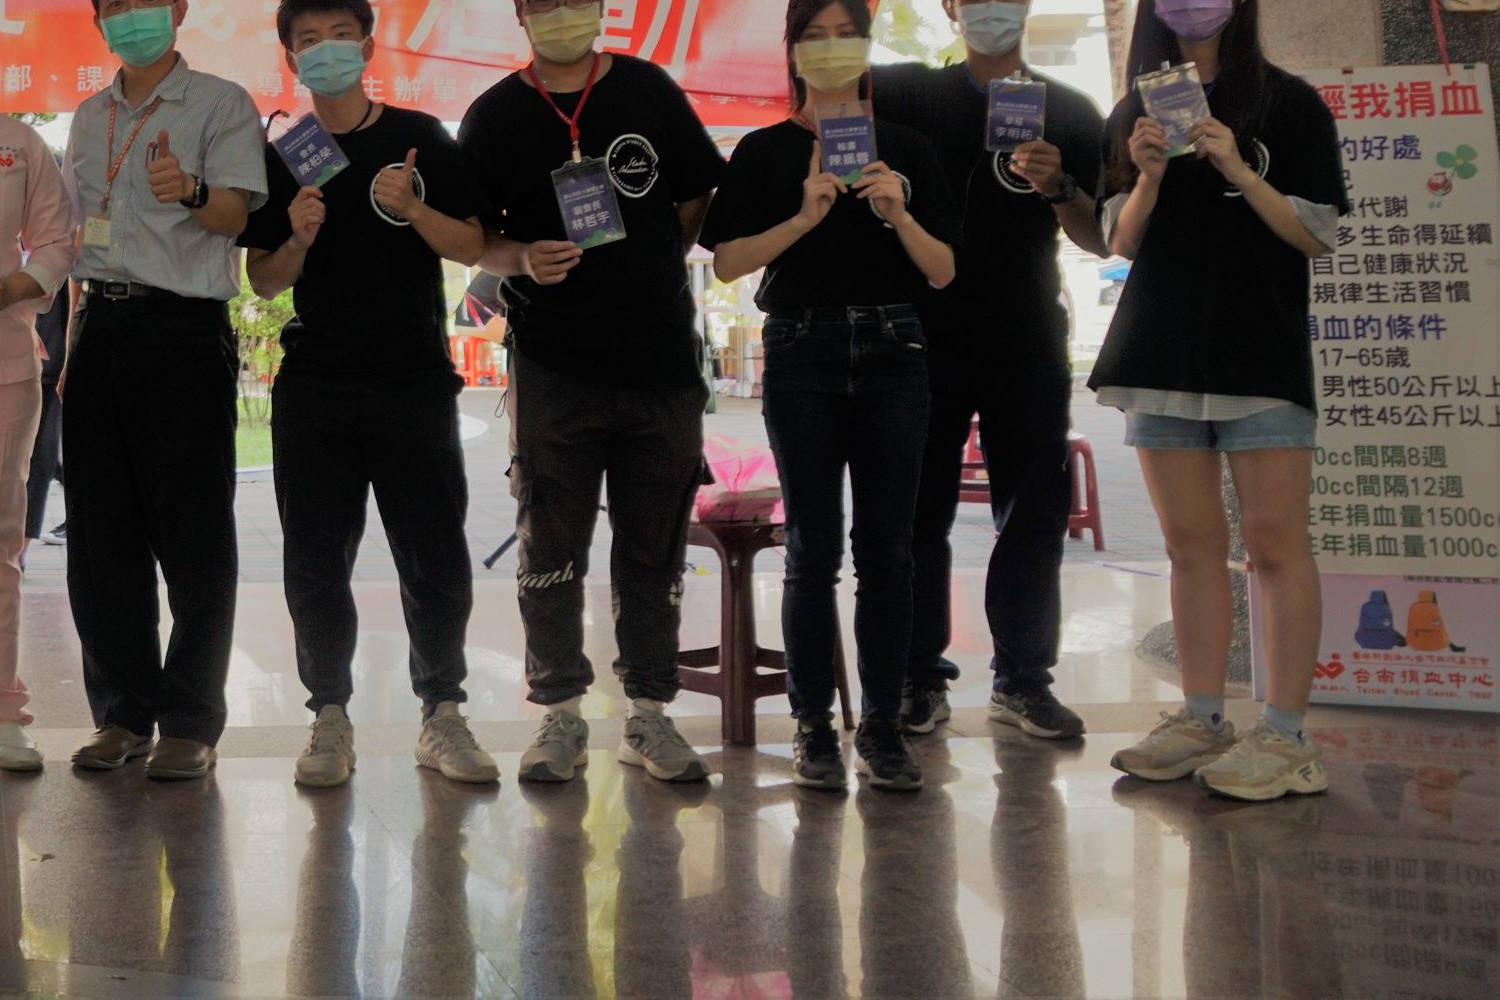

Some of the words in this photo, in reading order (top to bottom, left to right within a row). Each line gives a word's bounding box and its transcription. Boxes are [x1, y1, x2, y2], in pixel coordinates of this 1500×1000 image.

[1336, 222, 1492, 247] 多生命得延續
[1312, 251, 1468, 276] 自己健康狀況
[1313, 280, 1471, 304] 規律生活習慣
[1319, 346, 1411, 369] 17-65歲
[1307, 504, 1500, 528] 年捐血量1500c
[1352, 667, 1494, 689] 台南捐血中心
